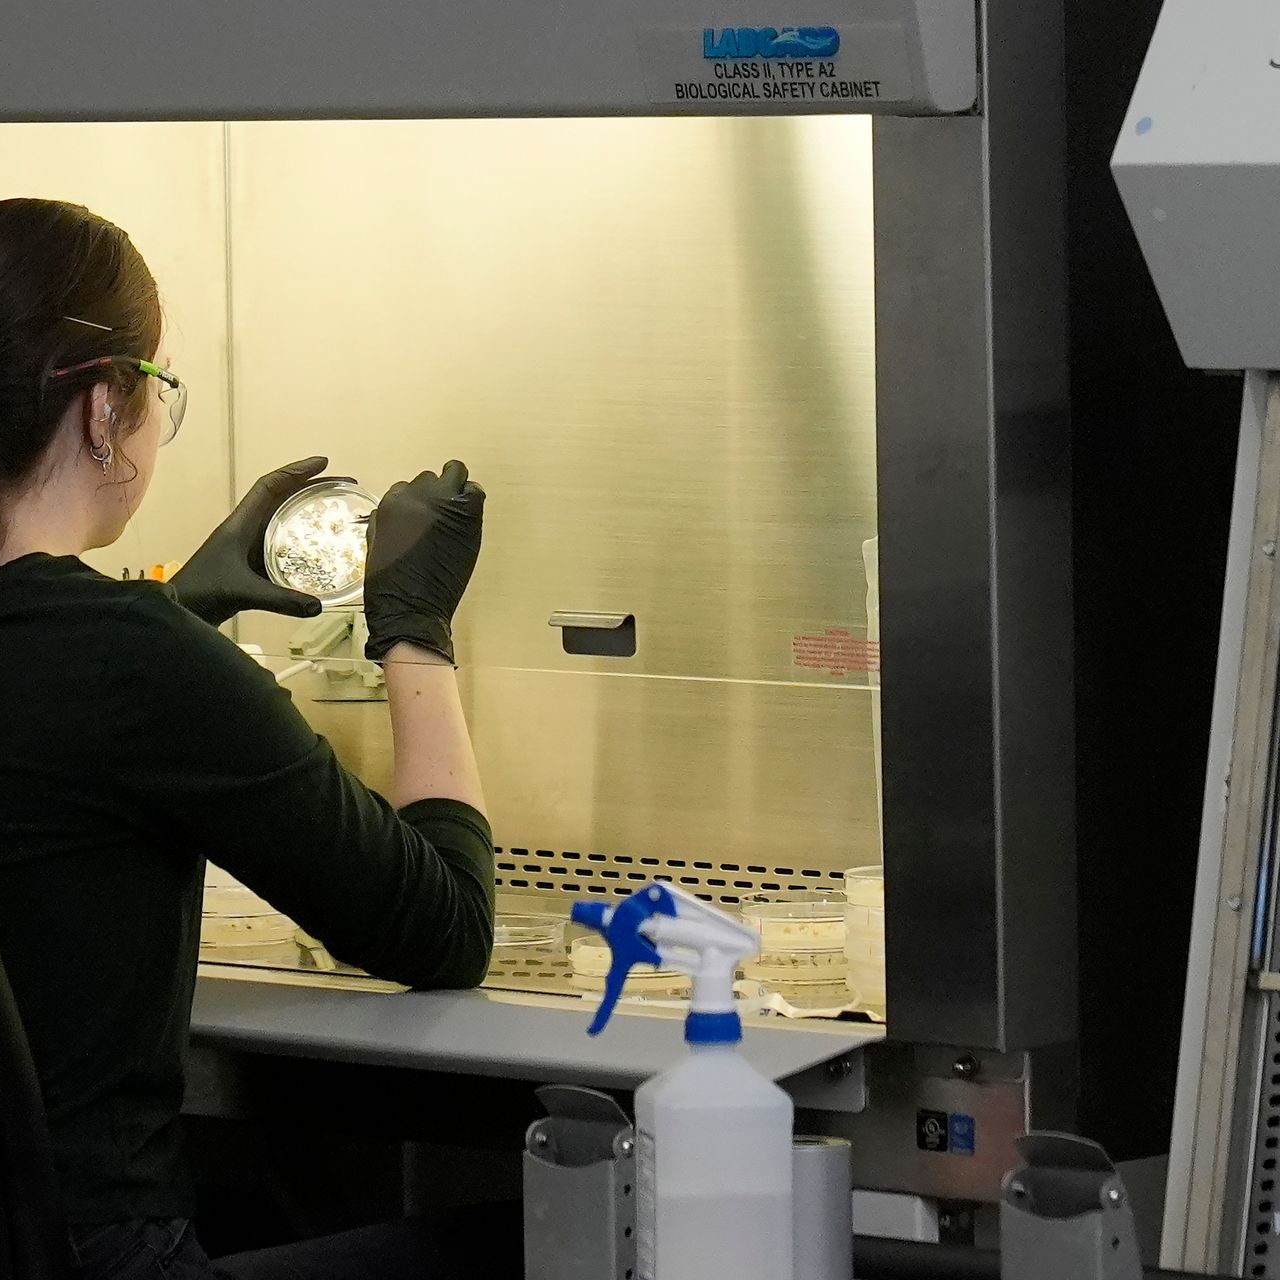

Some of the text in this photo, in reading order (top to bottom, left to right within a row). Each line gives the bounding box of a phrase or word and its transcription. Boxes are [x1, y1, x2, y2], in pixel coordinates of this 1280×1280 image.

[714, 62, 837, 81] CLASS II, TYPE A2
[675, 80, 881, 99] BIOLOGICAL SAFETY CABINET
